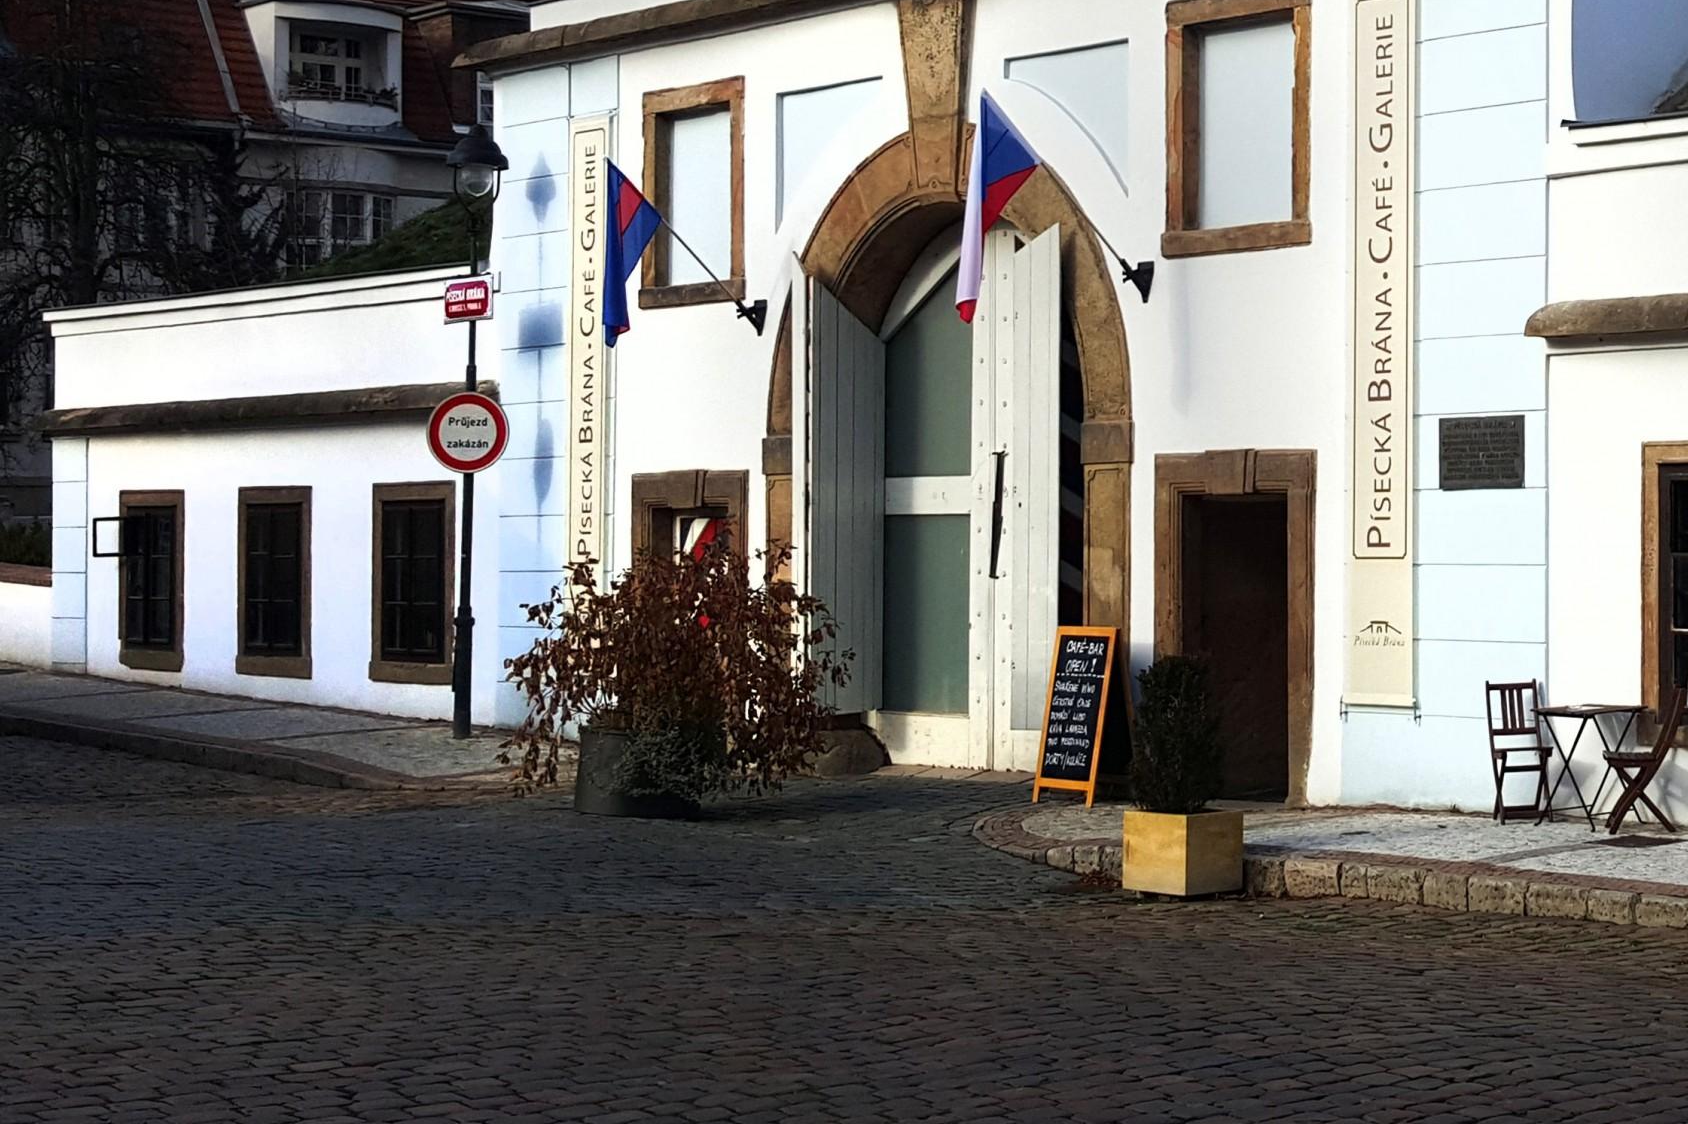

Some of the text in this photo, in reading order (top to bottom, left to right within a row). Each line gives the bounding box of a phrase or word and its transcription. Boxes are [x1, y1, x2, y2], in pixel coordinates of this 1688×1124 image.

[580, 144, 596, 252] GALERIE
[579, 270, 595, 337] CAFÉ
[1367, 13, 1394, 549] PÍSECKÁ BRÁNA CAFÉ GALERIE
[447, 414, 488, 428] Průjezd
[578, 354, 594, 445] BRÁNA
[446, 438, 489, 449] zakázán
[1065, 659, 1089, 673] OPEN
